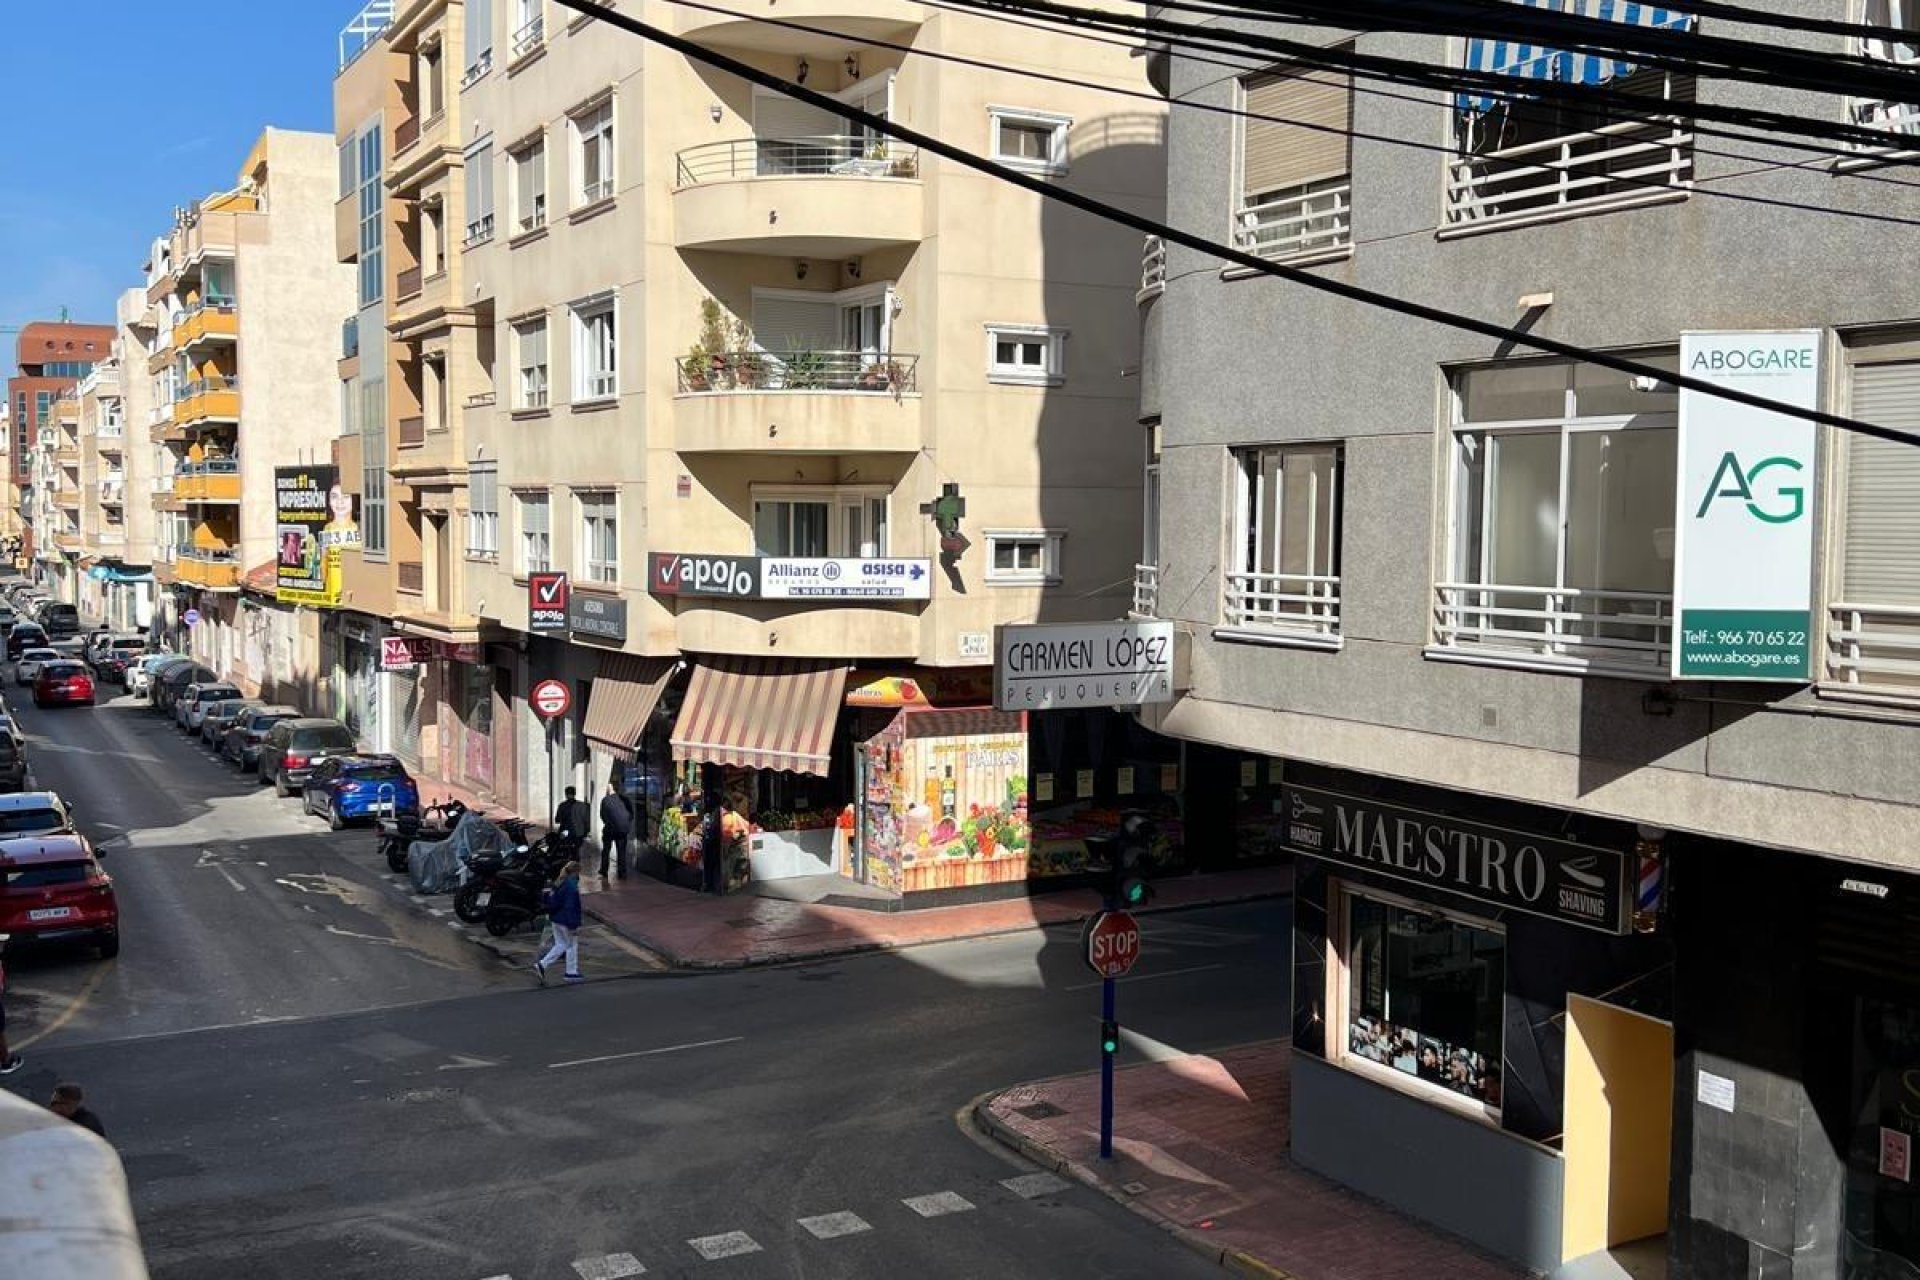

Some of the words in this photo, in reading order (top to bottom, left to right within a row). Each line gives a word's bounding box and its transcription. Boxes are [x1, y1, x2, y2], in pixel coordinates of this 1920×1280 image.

[1692, 349, 1813, 369] ABOGARE
[1696, 451, 1804, 524] AG
[680, 558, 752, 595] apolo
[768, 563, 819, 577] Allianz
[862, 563, 905, 575] asisa
[532, 610, 564, 620] apolo
[384, 640, 431, 655] NAILS
[1717, 630, 1743, 645] 966
[1746, 631, 1764, 645] 70
[1767, 631, 1785, 645] 65
[1787, 631, 1806, 646] 22
[1008, 639, 1093, 672] CARMEN
[1106, 628, 1168, 668] LÓPEZ
[1687, 650, 1801, 667] www.abogare.es
[1007, 679, 1168, 703] PELUQUERA
[1290, 824, 1322, 846] HAIRCUT
[1333, 805, 1545, 901] MAESTRO
[1560, 889, 1605, 917] SHAVING
[1095, 930, 1137, 959] STOP
